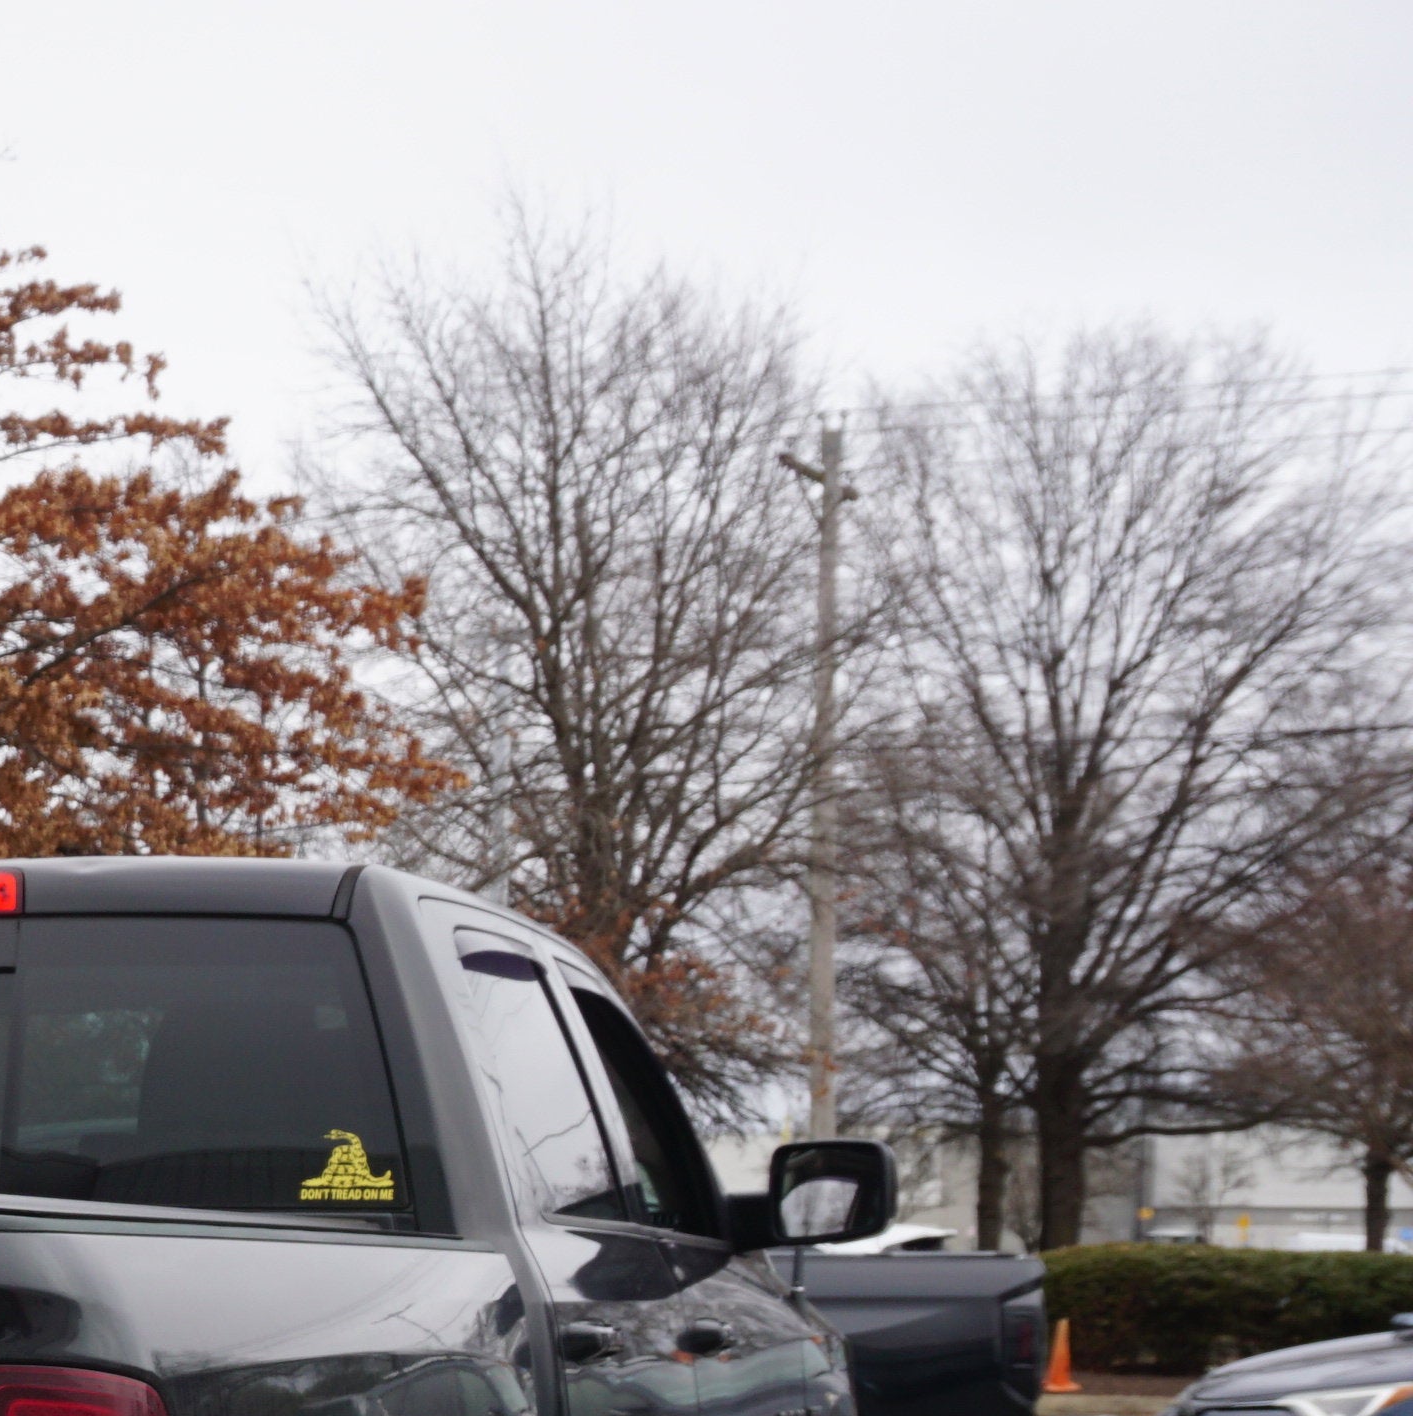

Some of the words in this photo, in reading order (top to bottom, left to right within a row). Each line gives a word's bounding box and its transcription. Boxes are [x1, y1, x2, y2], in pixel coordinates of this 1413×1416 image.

[300, 1188, 330, 1200] DON'T
[331, 1188, 362, 1200] TREAD
[363, 1188, 378, 1200] ON
[379, 1188, 394, 1200] ME
